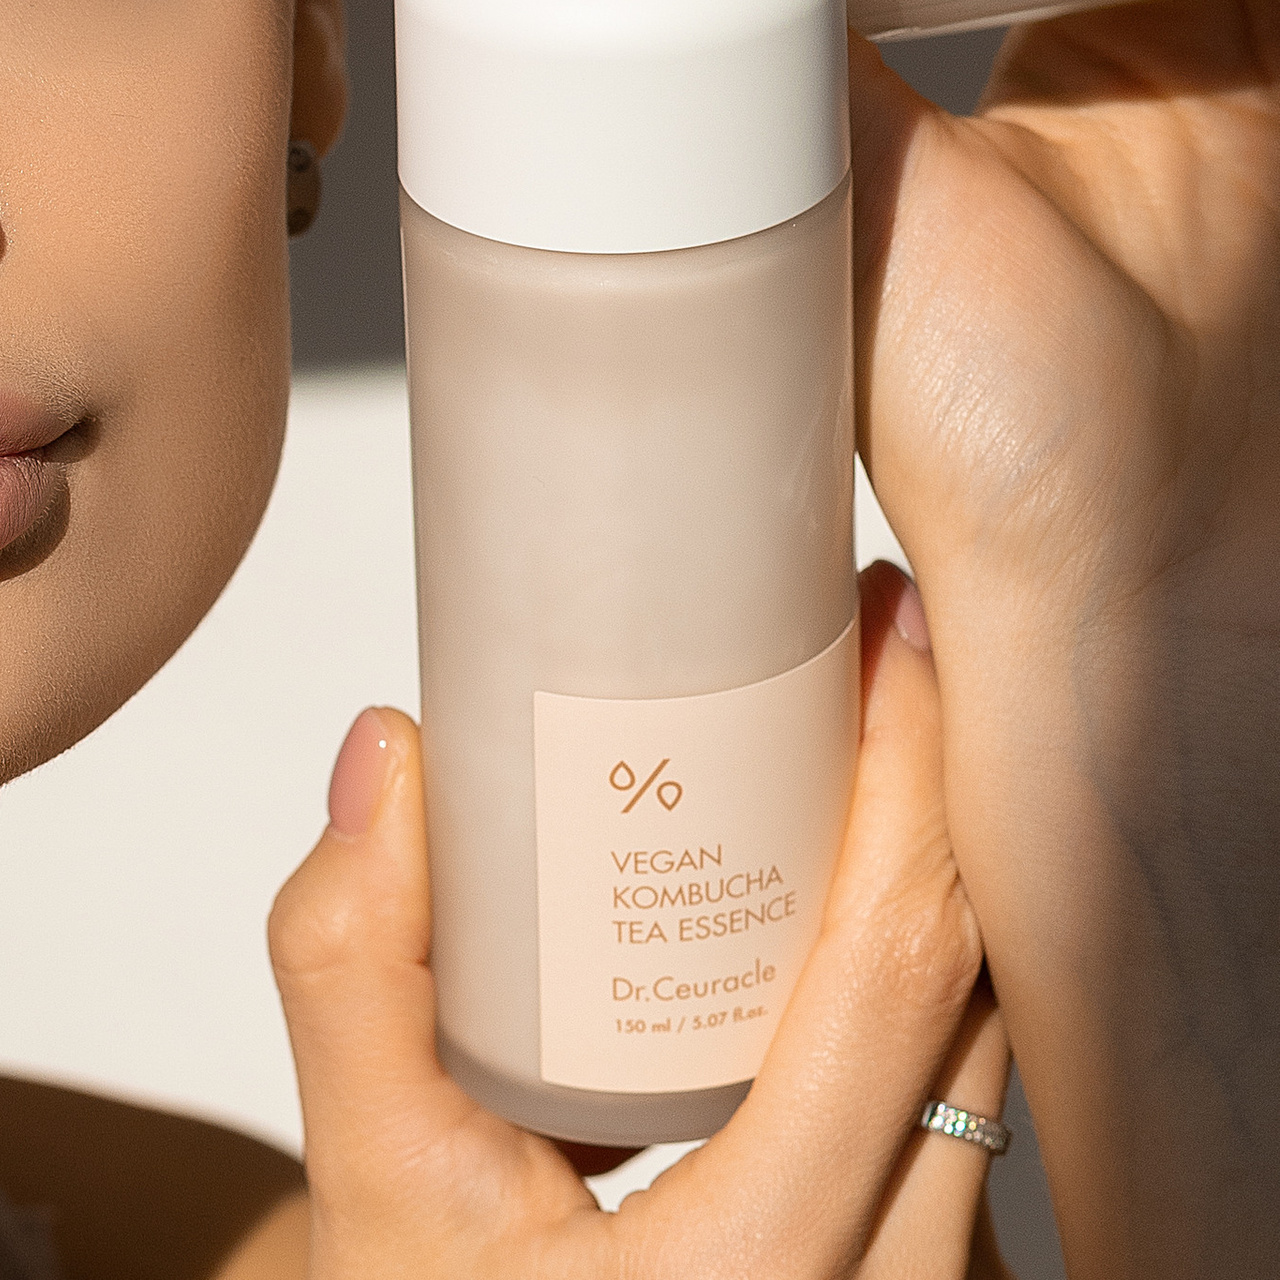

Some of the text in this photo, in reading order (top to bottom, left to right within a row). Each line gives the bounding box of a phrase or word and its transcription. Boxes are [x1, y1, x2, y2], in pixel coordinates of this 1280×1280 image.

[610, 843, 723, 875] VEGAN
[612, 864, 784, 910] KOMBUCHA
[612, 889, 797, 945] TEA ESSENCE
[612, 957, 777, 1003] Dr.Ceuracle
[615, 1018, 646, 1034] 150
[651, 1018, 672, 1033] ml
[692, 1011, 728, 1031] 5.07
